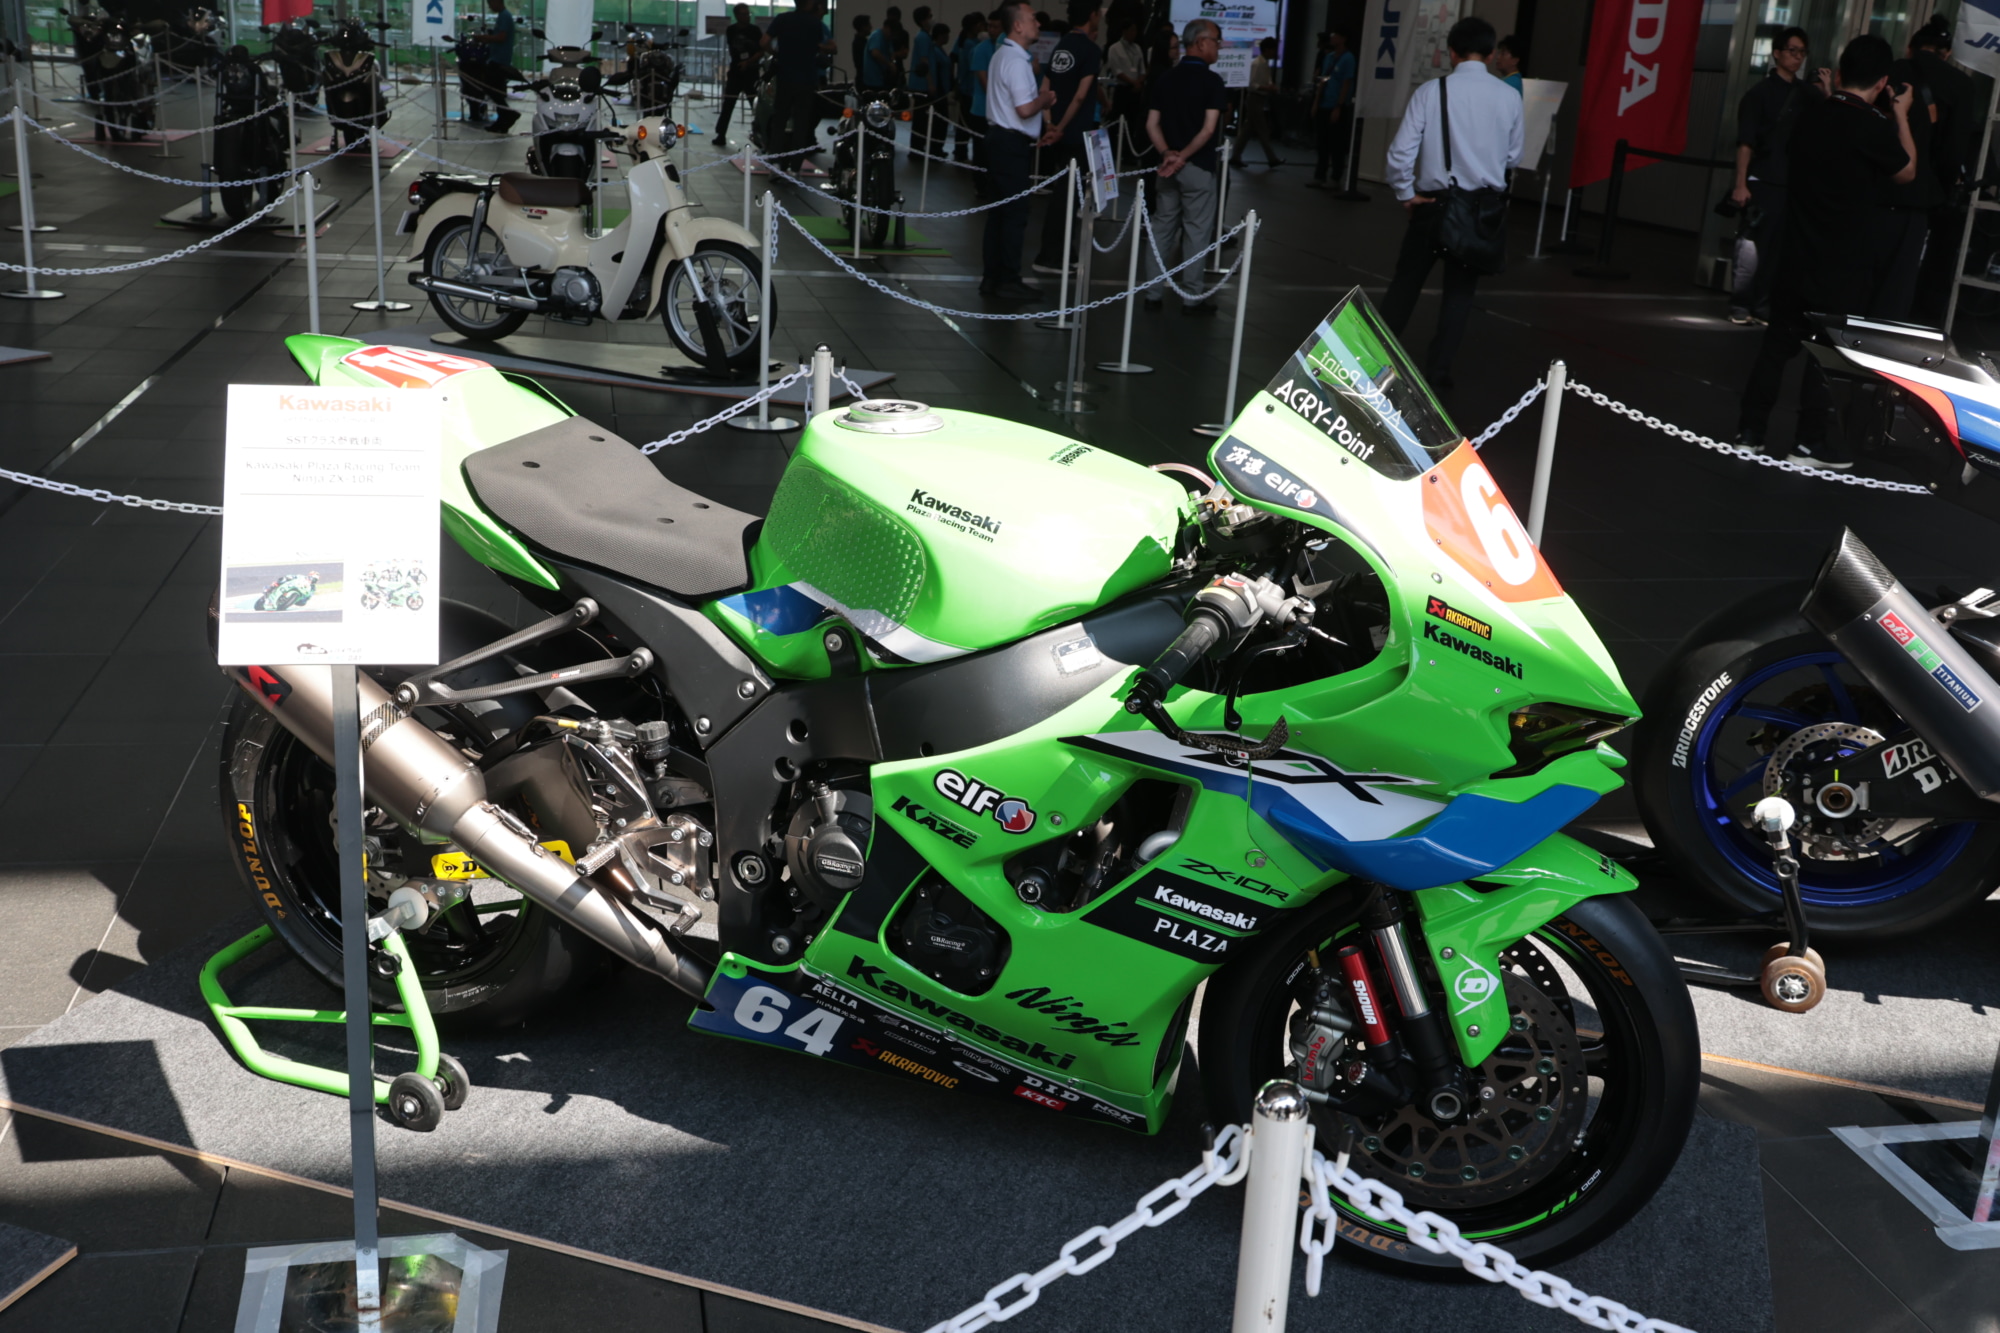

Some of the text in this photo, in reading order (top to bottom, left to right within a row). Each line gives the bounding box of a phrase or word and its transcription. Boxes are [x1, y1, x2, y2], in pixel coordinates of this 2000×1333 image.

[279, 394, 392, 413] Kawasaki
[246, 461, 421, 473] Kawasaki Plaza Racing Team
[292, 474, 374, 484] Ninja ZX-10R
[1264, 472, 1301, 497] elf
[906, 504, 995, 543] Plaza Racing Team
[910, 488, 1003, 535] Kawasaki
[1445, 608, 1490, 639] AKRAPOVIC
[1424, 621, 1523, 680] Kawasaki
[1936, 666, 1977, 707] TITANIUM
[1672, 671, 1732, 769] BRIDGESTONE
[934, 770, 1001, 814] elf
[891, 795, 977, 850] KAZE
[238, 803, 283, 909] DUNLOP
[1178, 858, 1290, 902] ZX-10R
[1154, 885, 1258, 930] Kawasaki
[1153, 917, 1230, 953] PLAZA
[811, 983, 858, 1010] AELLA
[846, 955, 1077, 1071] Kawasaki
[1005, 986, 1141, 1047] Ninja
[1352, 979, 1379, 1026] SHOWA
[733, 985, 846, 1057] 64
[900, 1024, 941, 1043] A-TECH
[878, 1050, 959, 1089] AKRAPOVIC
[1303, 1035, 1326, 1081] brembo
[1021, 1089, 1060, 1108] KTC
[1022, 1075, 1081, 1102] D.I.D
